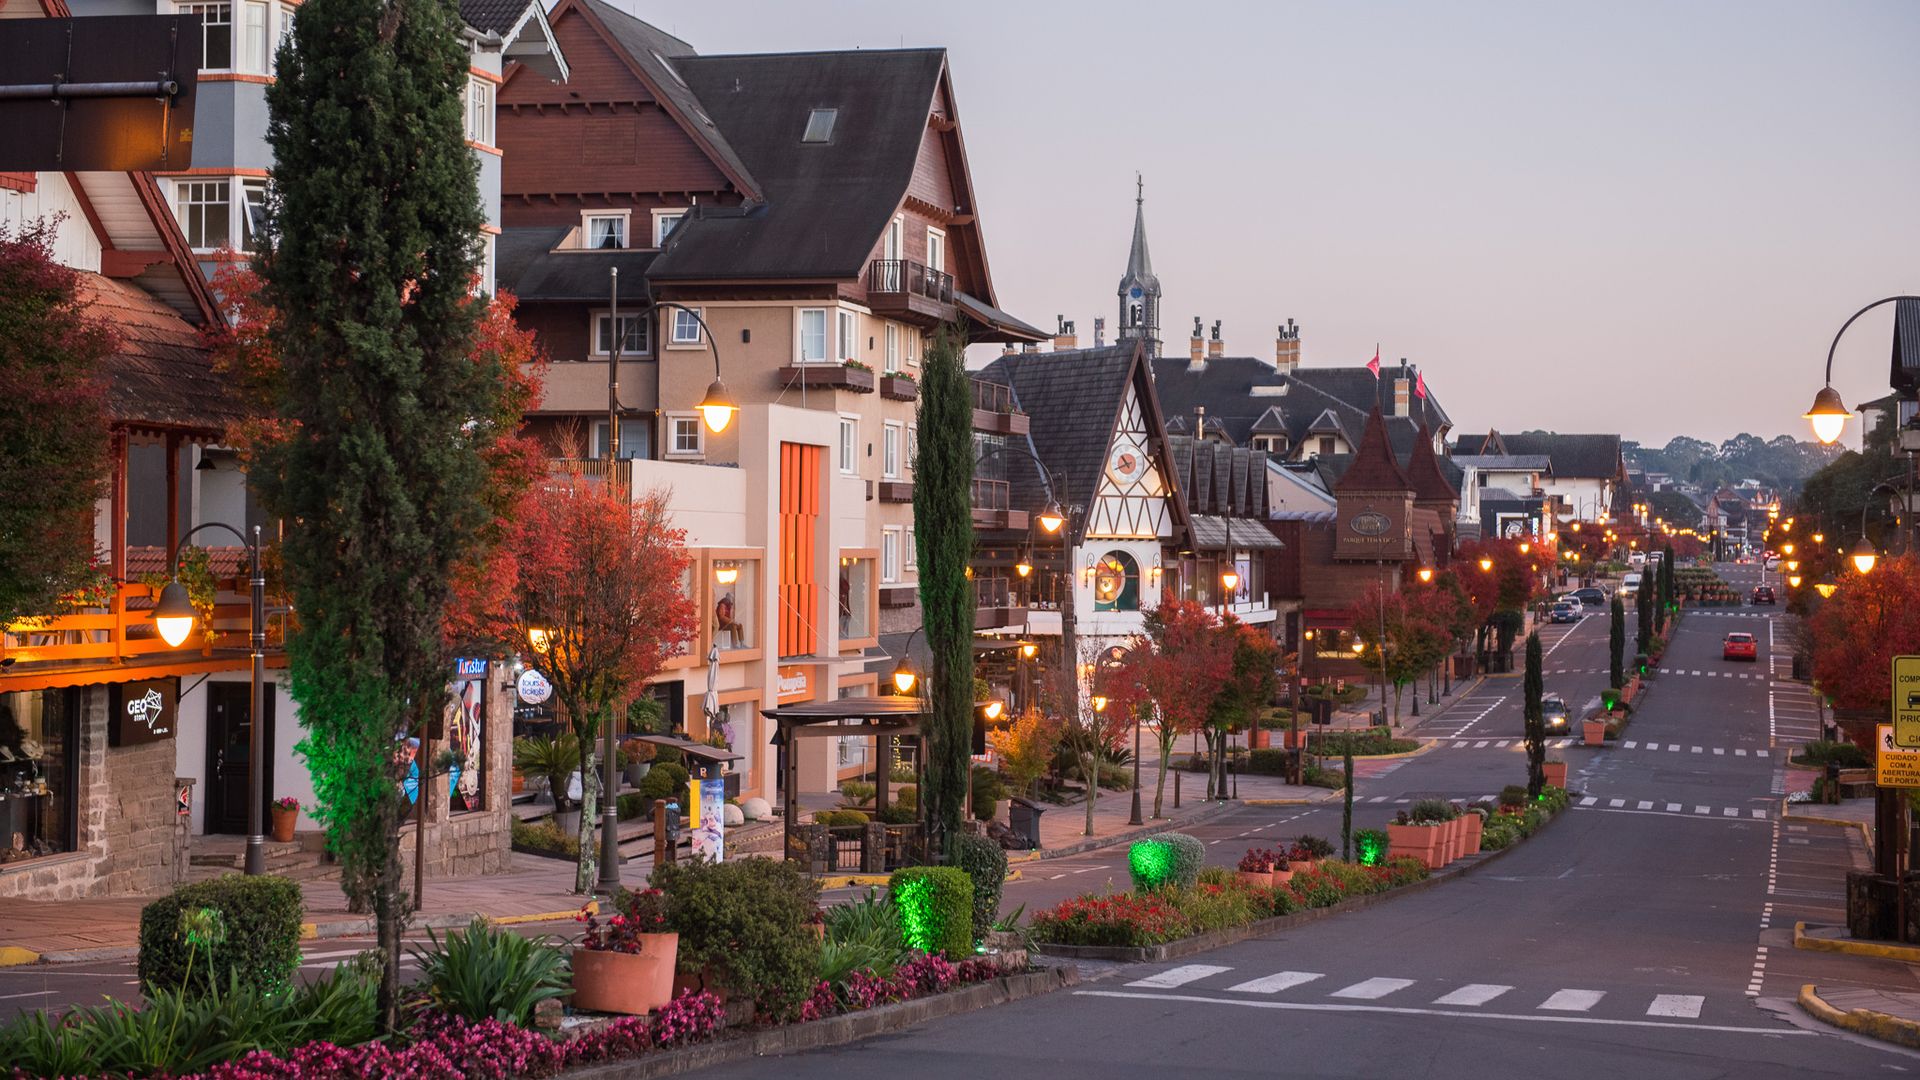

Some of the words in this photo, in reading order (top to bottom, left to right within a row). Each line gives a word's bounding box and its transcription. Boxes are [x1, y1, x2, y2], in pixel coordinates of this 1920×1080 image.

[127, 698, 147, 715] GEO
[1885, 753, 1918, 761] CUIDADO
[1889, 761, 1906, 769] COM
[1882, 769, 1920, 777] ABERTURA
[1883, 776, 1894, 784] DE
